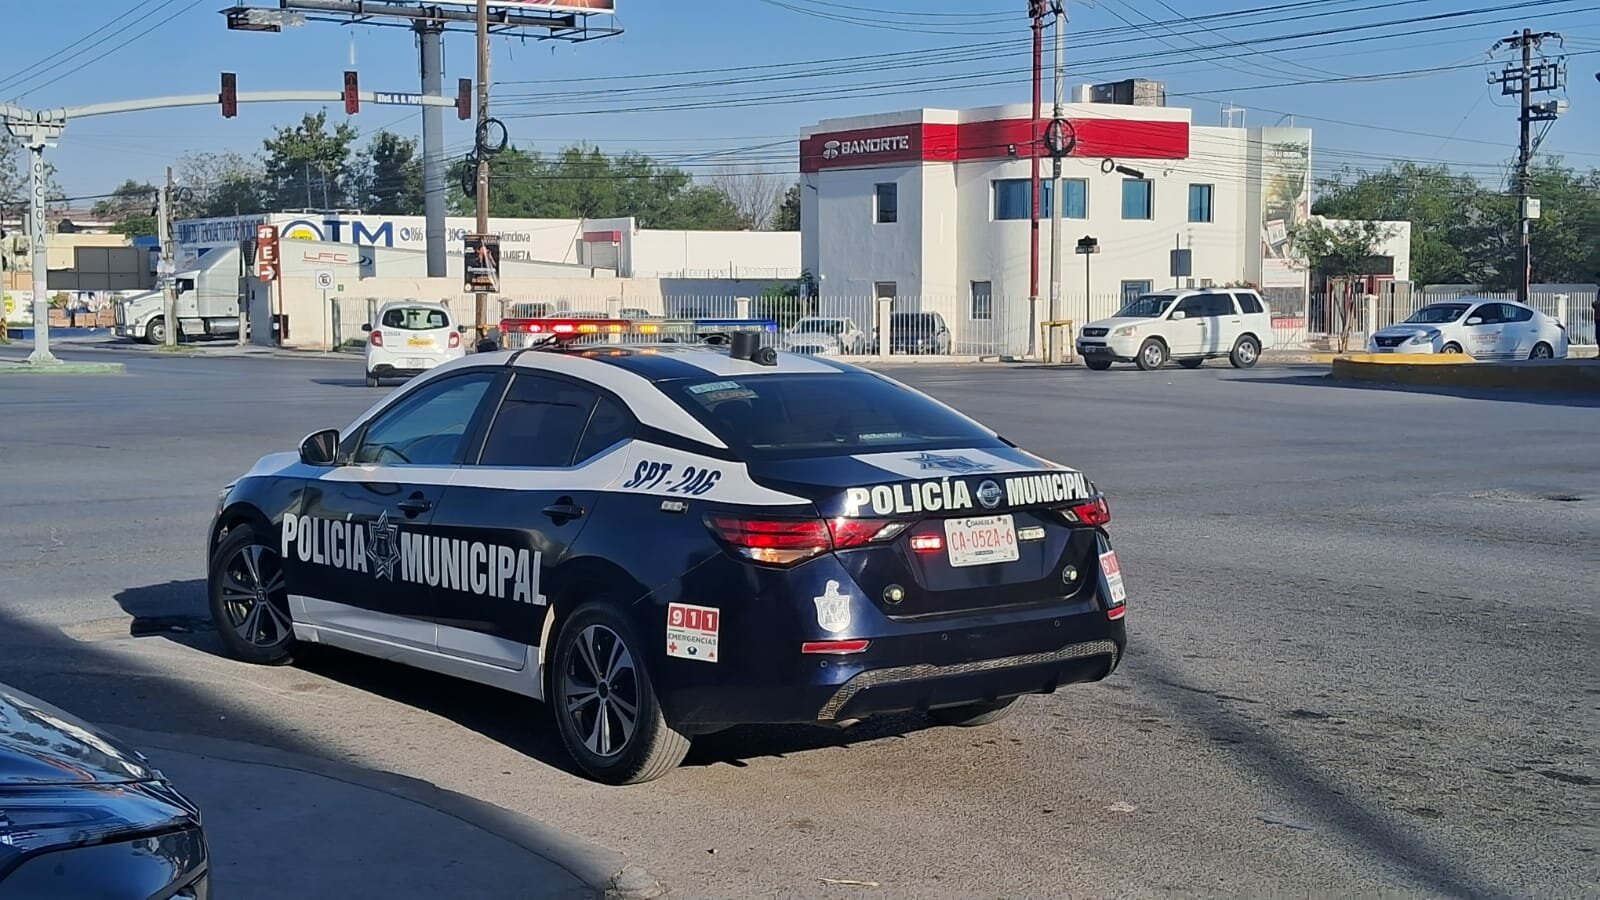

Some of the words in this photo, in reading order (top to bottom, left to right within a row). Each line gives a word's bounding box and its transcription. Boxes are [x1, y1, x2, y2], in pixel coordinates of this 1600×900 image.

[841, 135, 909, 154] BANORTE
[845, 476, 973, 517] POLICÍA
[1005, 472, 1089, 506] MUNICIPAL
[951, 528, 1013, 551] CA-052A-6
[281, 512, 368, 573] POLICÍA
[400, 532, 547, 606] MUNICIPAL
[672, 610, 713, 629] 911
[668, 632, 716, 646] EMERGENCIAS
